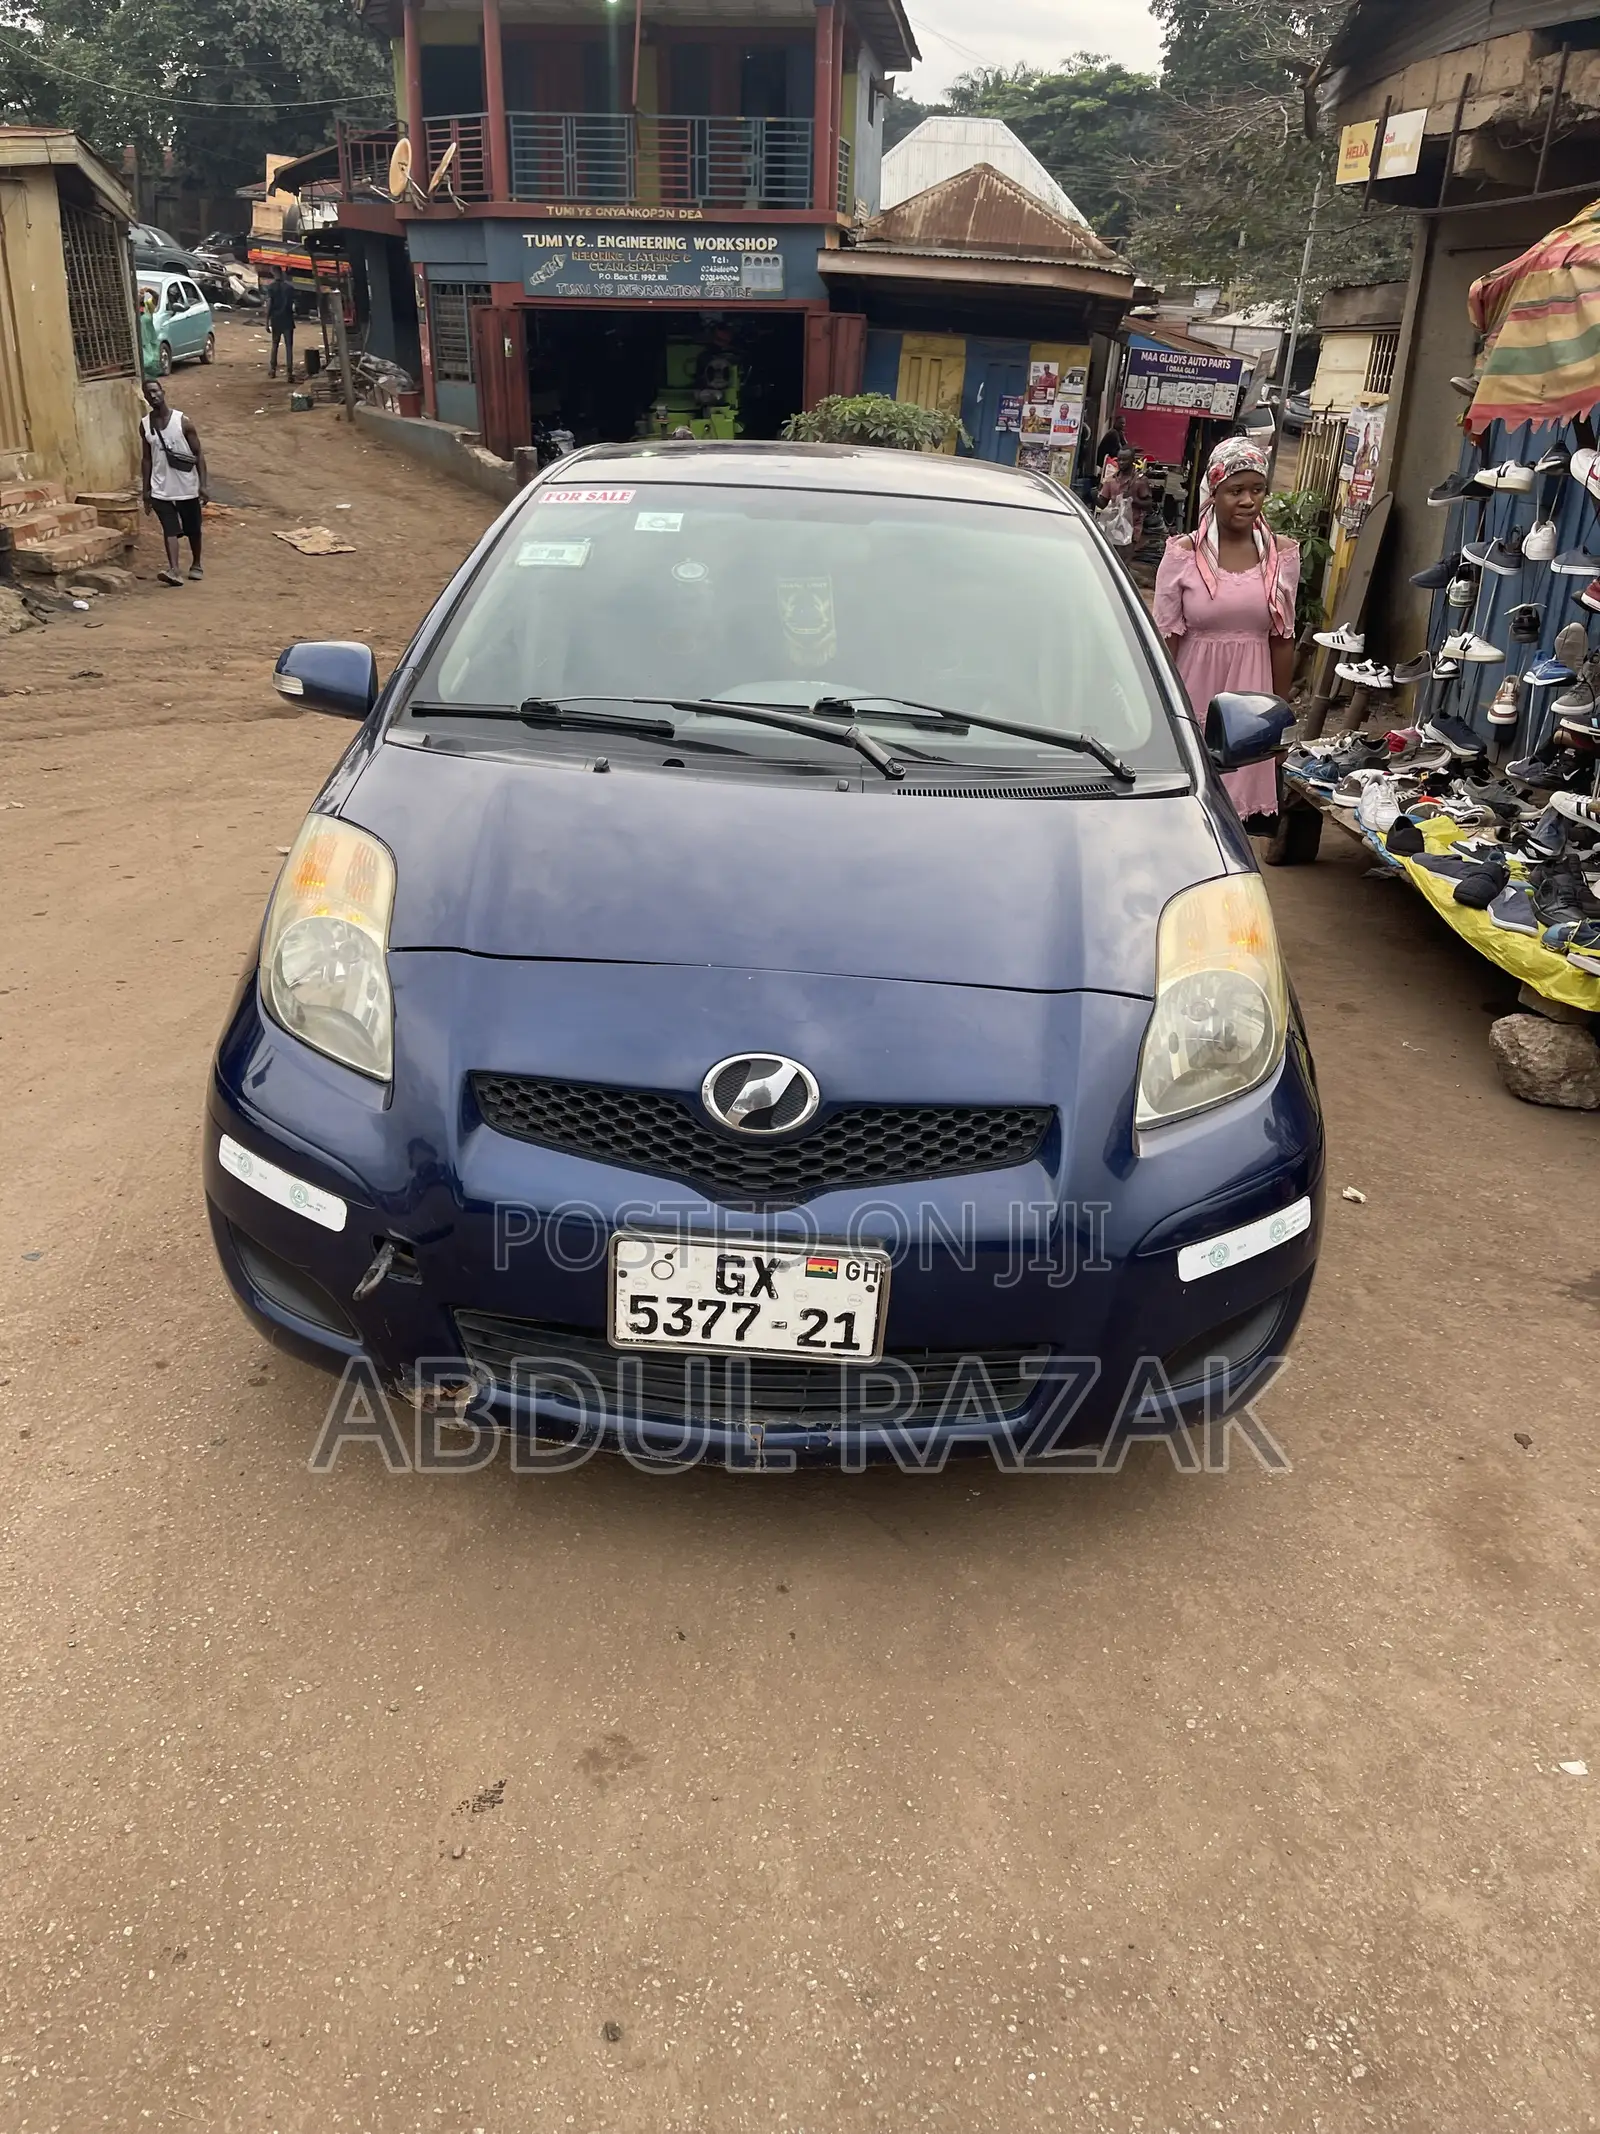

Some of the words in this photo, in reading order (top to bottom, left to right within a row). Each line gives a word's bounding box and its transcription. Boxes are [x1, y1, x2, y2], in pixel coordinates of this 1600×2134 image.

[1346, 139, 1369, 160] HELIX
[546, 206, 574, 216] TUMI
[679, 209, 703, 219] DEA
[522, 234, 562, 248] TUMI
[597, 235, 687, 250] ENGINEERING
[693, 237, 778, 251] WORKSHOP
[589, 262, 672, 273] CRANKSHAFT
[613, 273, 628, 281] Box
[555, 283, 591, 296] TUMI
[617, 283, 700, 298] INFORMATION
[704, 284, 753, 298] CENTRE
[1141, 351, 1158, 361] MAA
[1159, 353, 1187, 366] GLADYS
[1187, 357, 1208, 367] AUTO
[1209, 358, 1231, 370] PARTS
[545, 491, 581, 501] FOR
[586, 491, 631, 501] SALE
[715, 1253, 782, 1300] GX
[845, 1260, 879, 1283] GH
